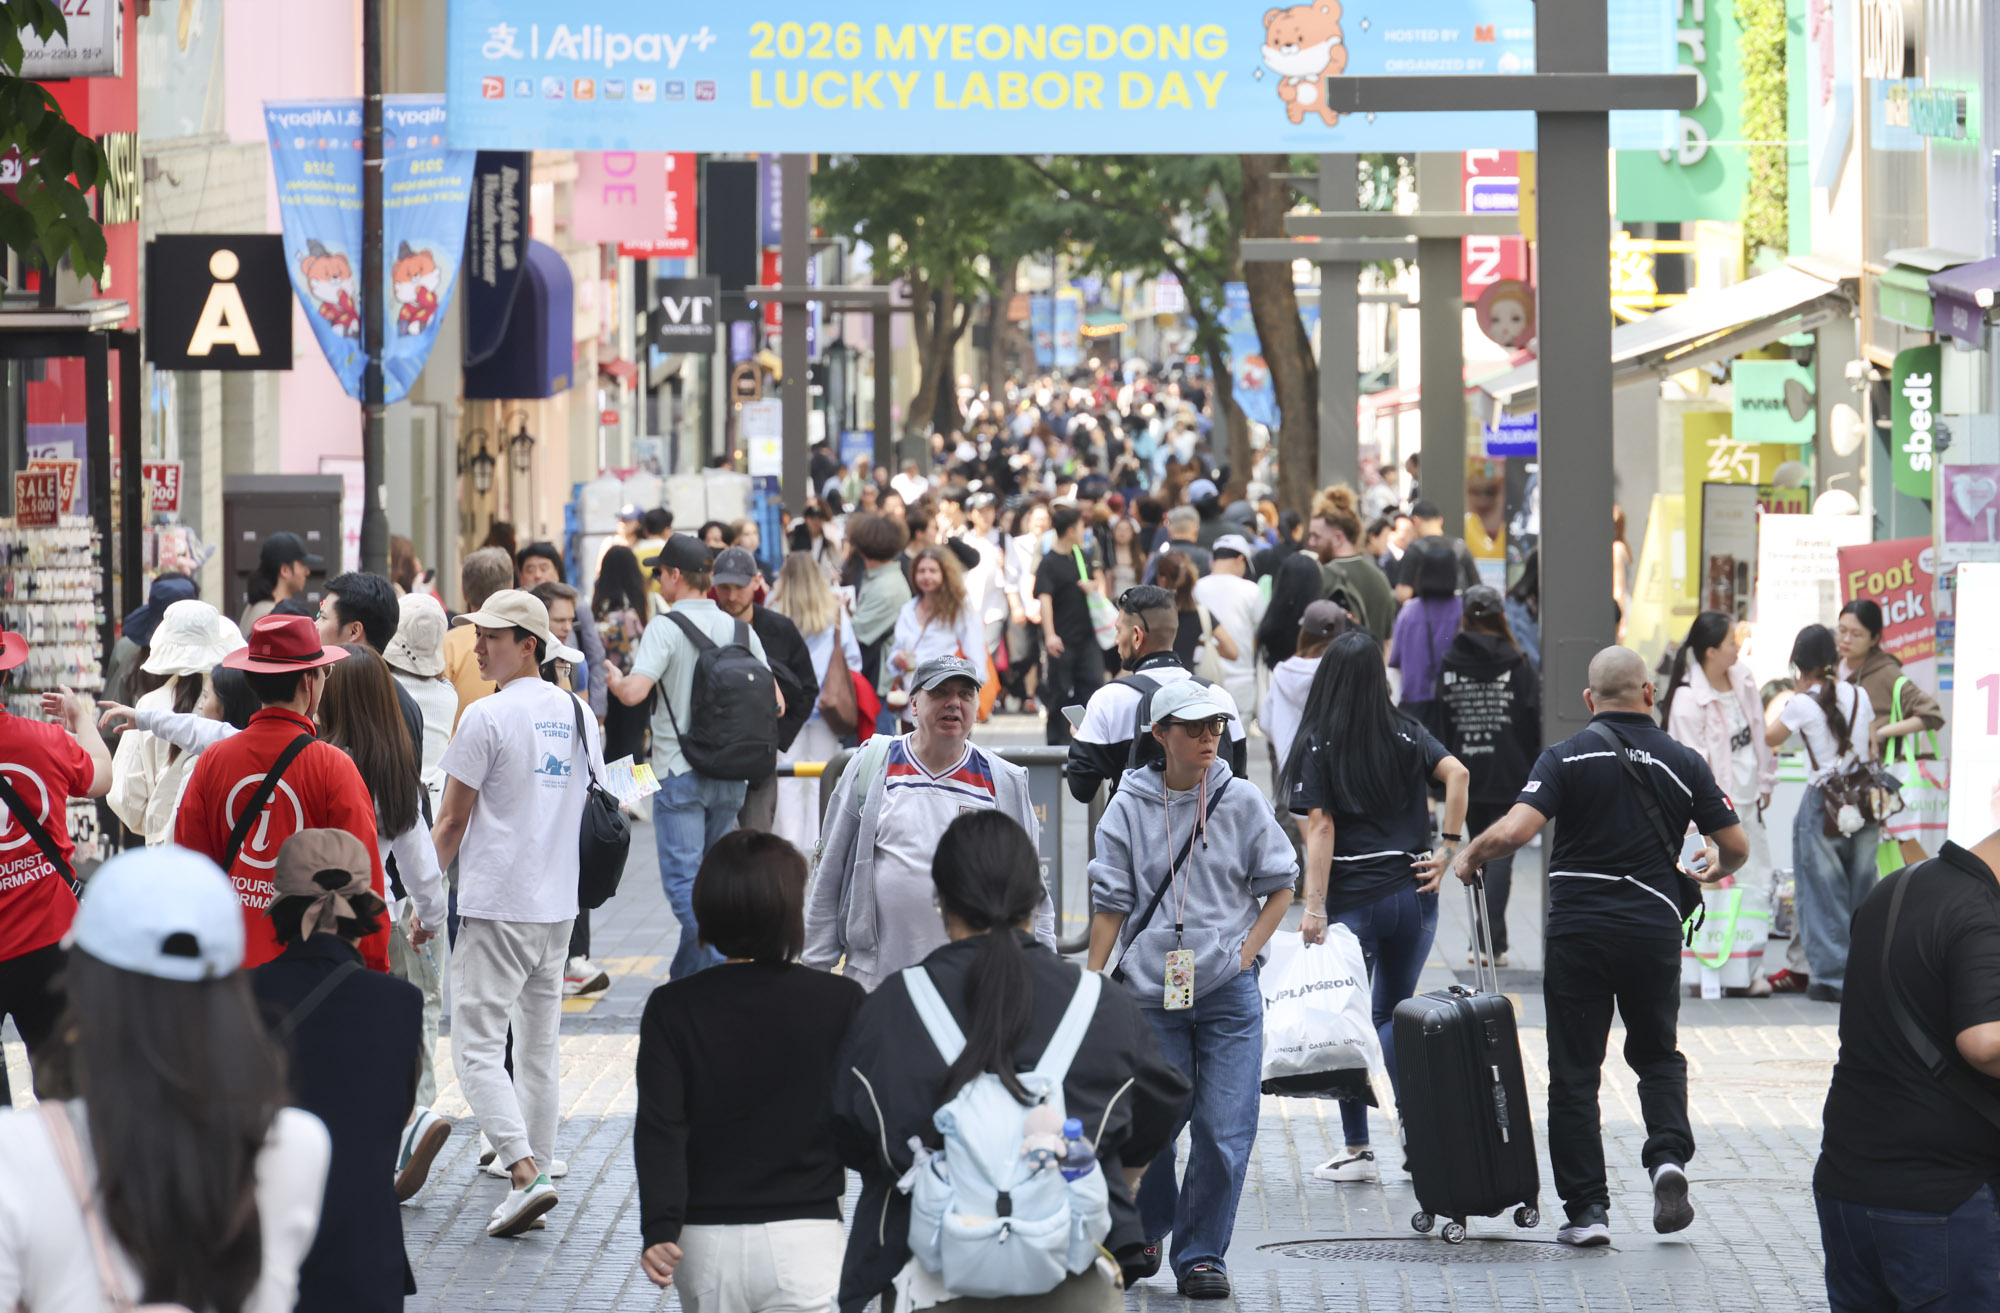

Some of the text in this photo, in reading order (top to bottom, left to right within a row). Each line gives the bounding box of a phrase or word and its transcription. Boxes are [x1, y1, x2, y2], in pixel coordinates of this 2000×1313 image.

[545, 23, 717, 69] Alipay+
[748, 21, 1229, 60] 2026 MYEONGDONG
[750, 69, 1229, 110] LUCKY LABOR DAY
[661, 295, 713, 325] VT
[1902, 372, 1933, 472] sbedt
[17, 477, 56, 499] SALE
[1848, 558, 1916, 600] Foot
[535, 720, 573, 731] DUCKIN
[542, 729, 569, 739] TIRED
[1308, 1040, 1338, 1050] CASUAL
